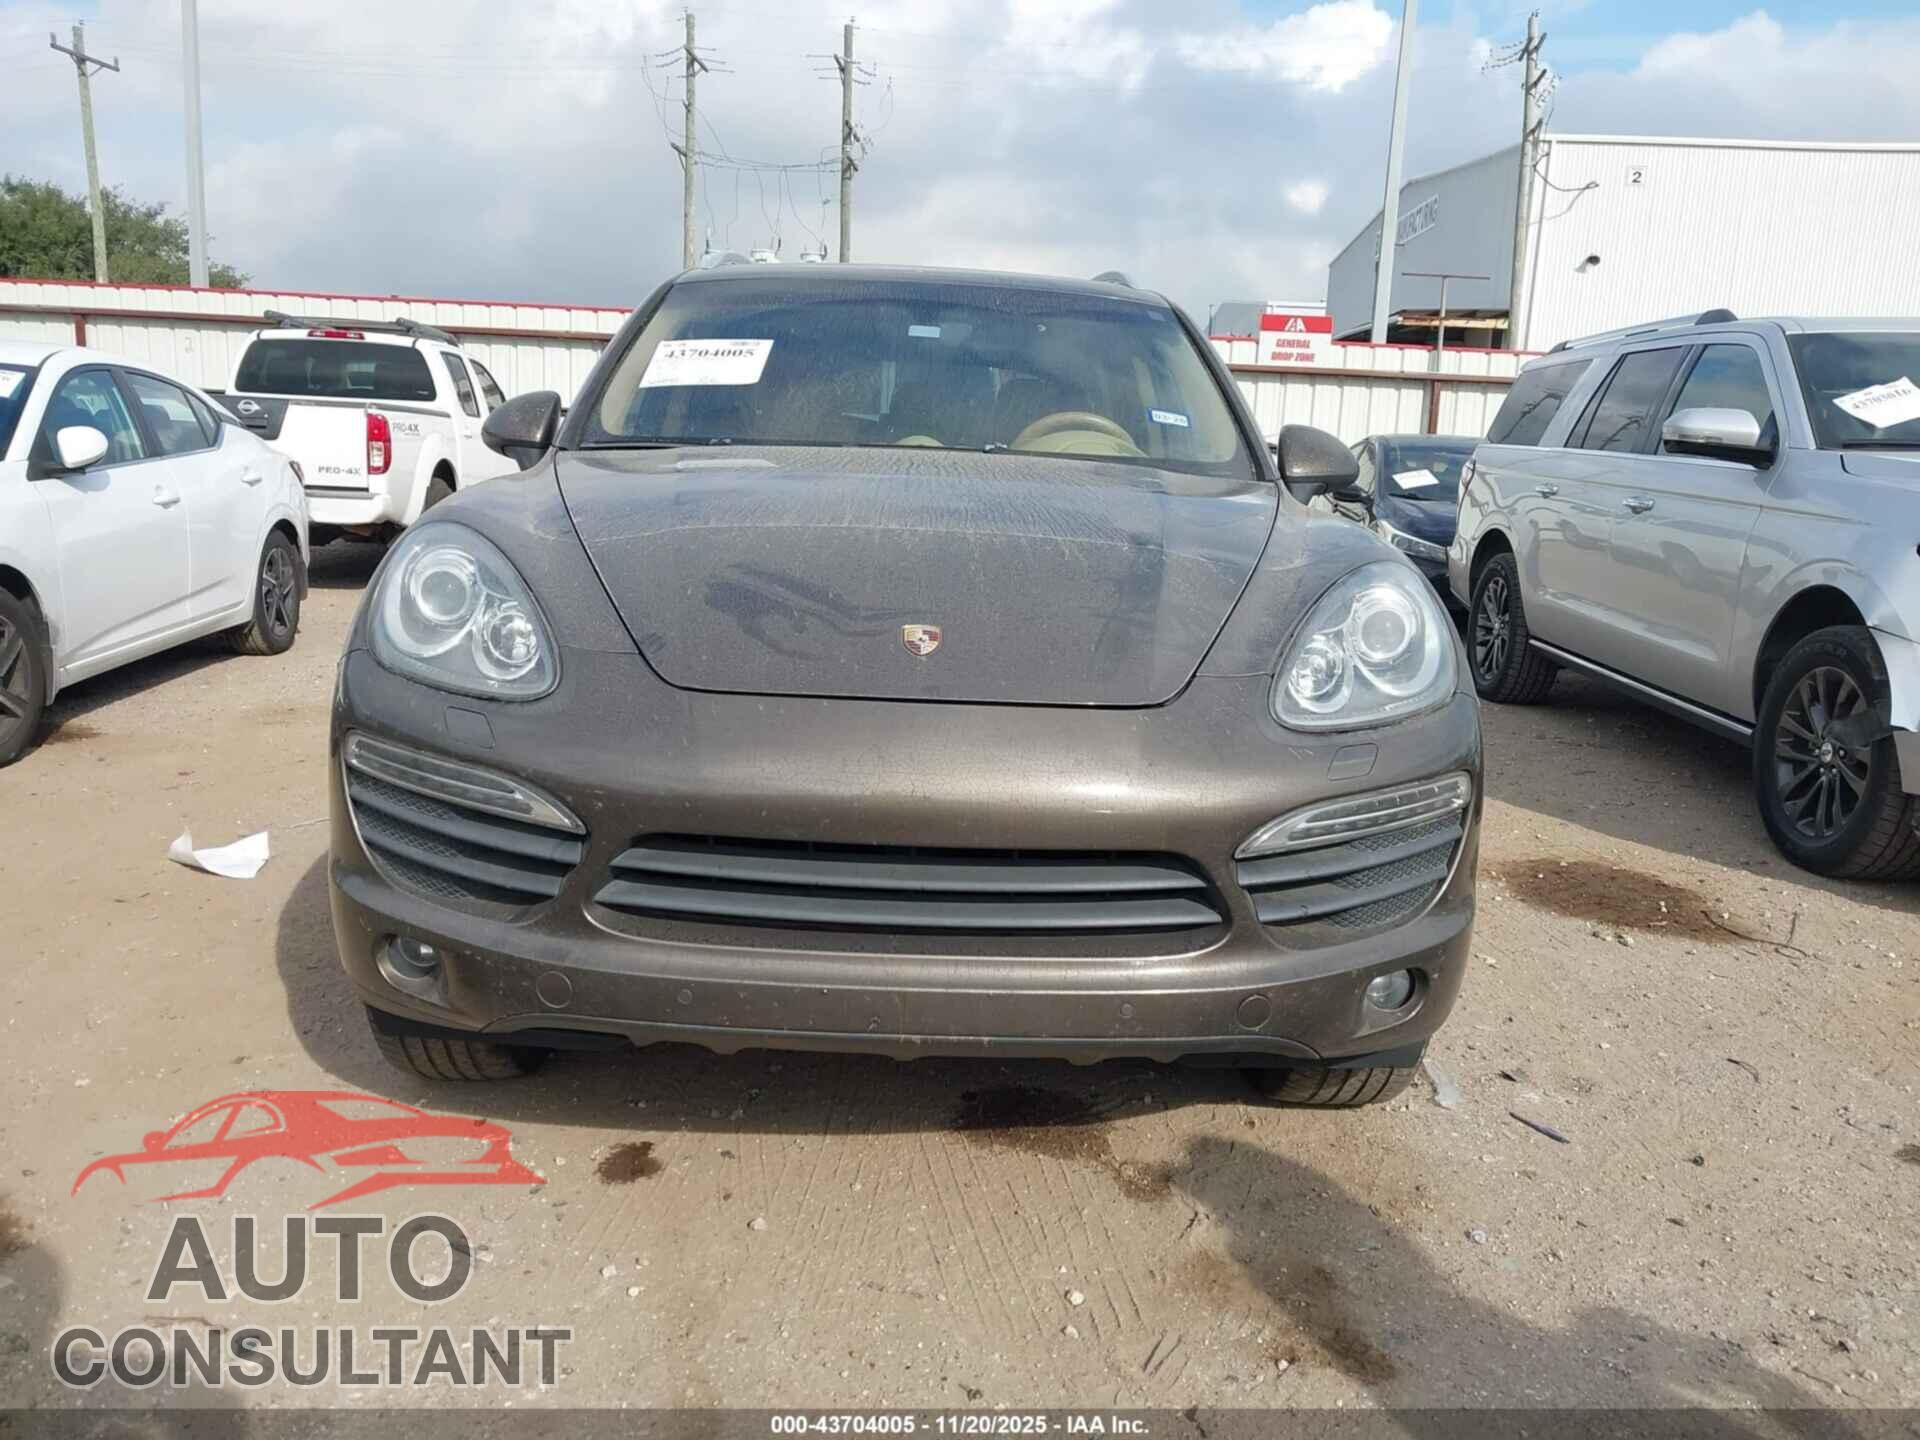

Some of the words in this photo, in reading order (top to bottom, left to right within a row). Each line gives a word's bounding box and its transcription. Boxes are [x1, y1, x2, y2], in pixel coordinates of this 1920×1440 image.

[1631, 171, 1642, 183] 2
[1276, 339, 1310, 348] GENERAL
[664, 349, 754, 358] 43704005
[1271, 352, 1294, 361] DROP
[1295, 353, 1315, 362] ZONE
